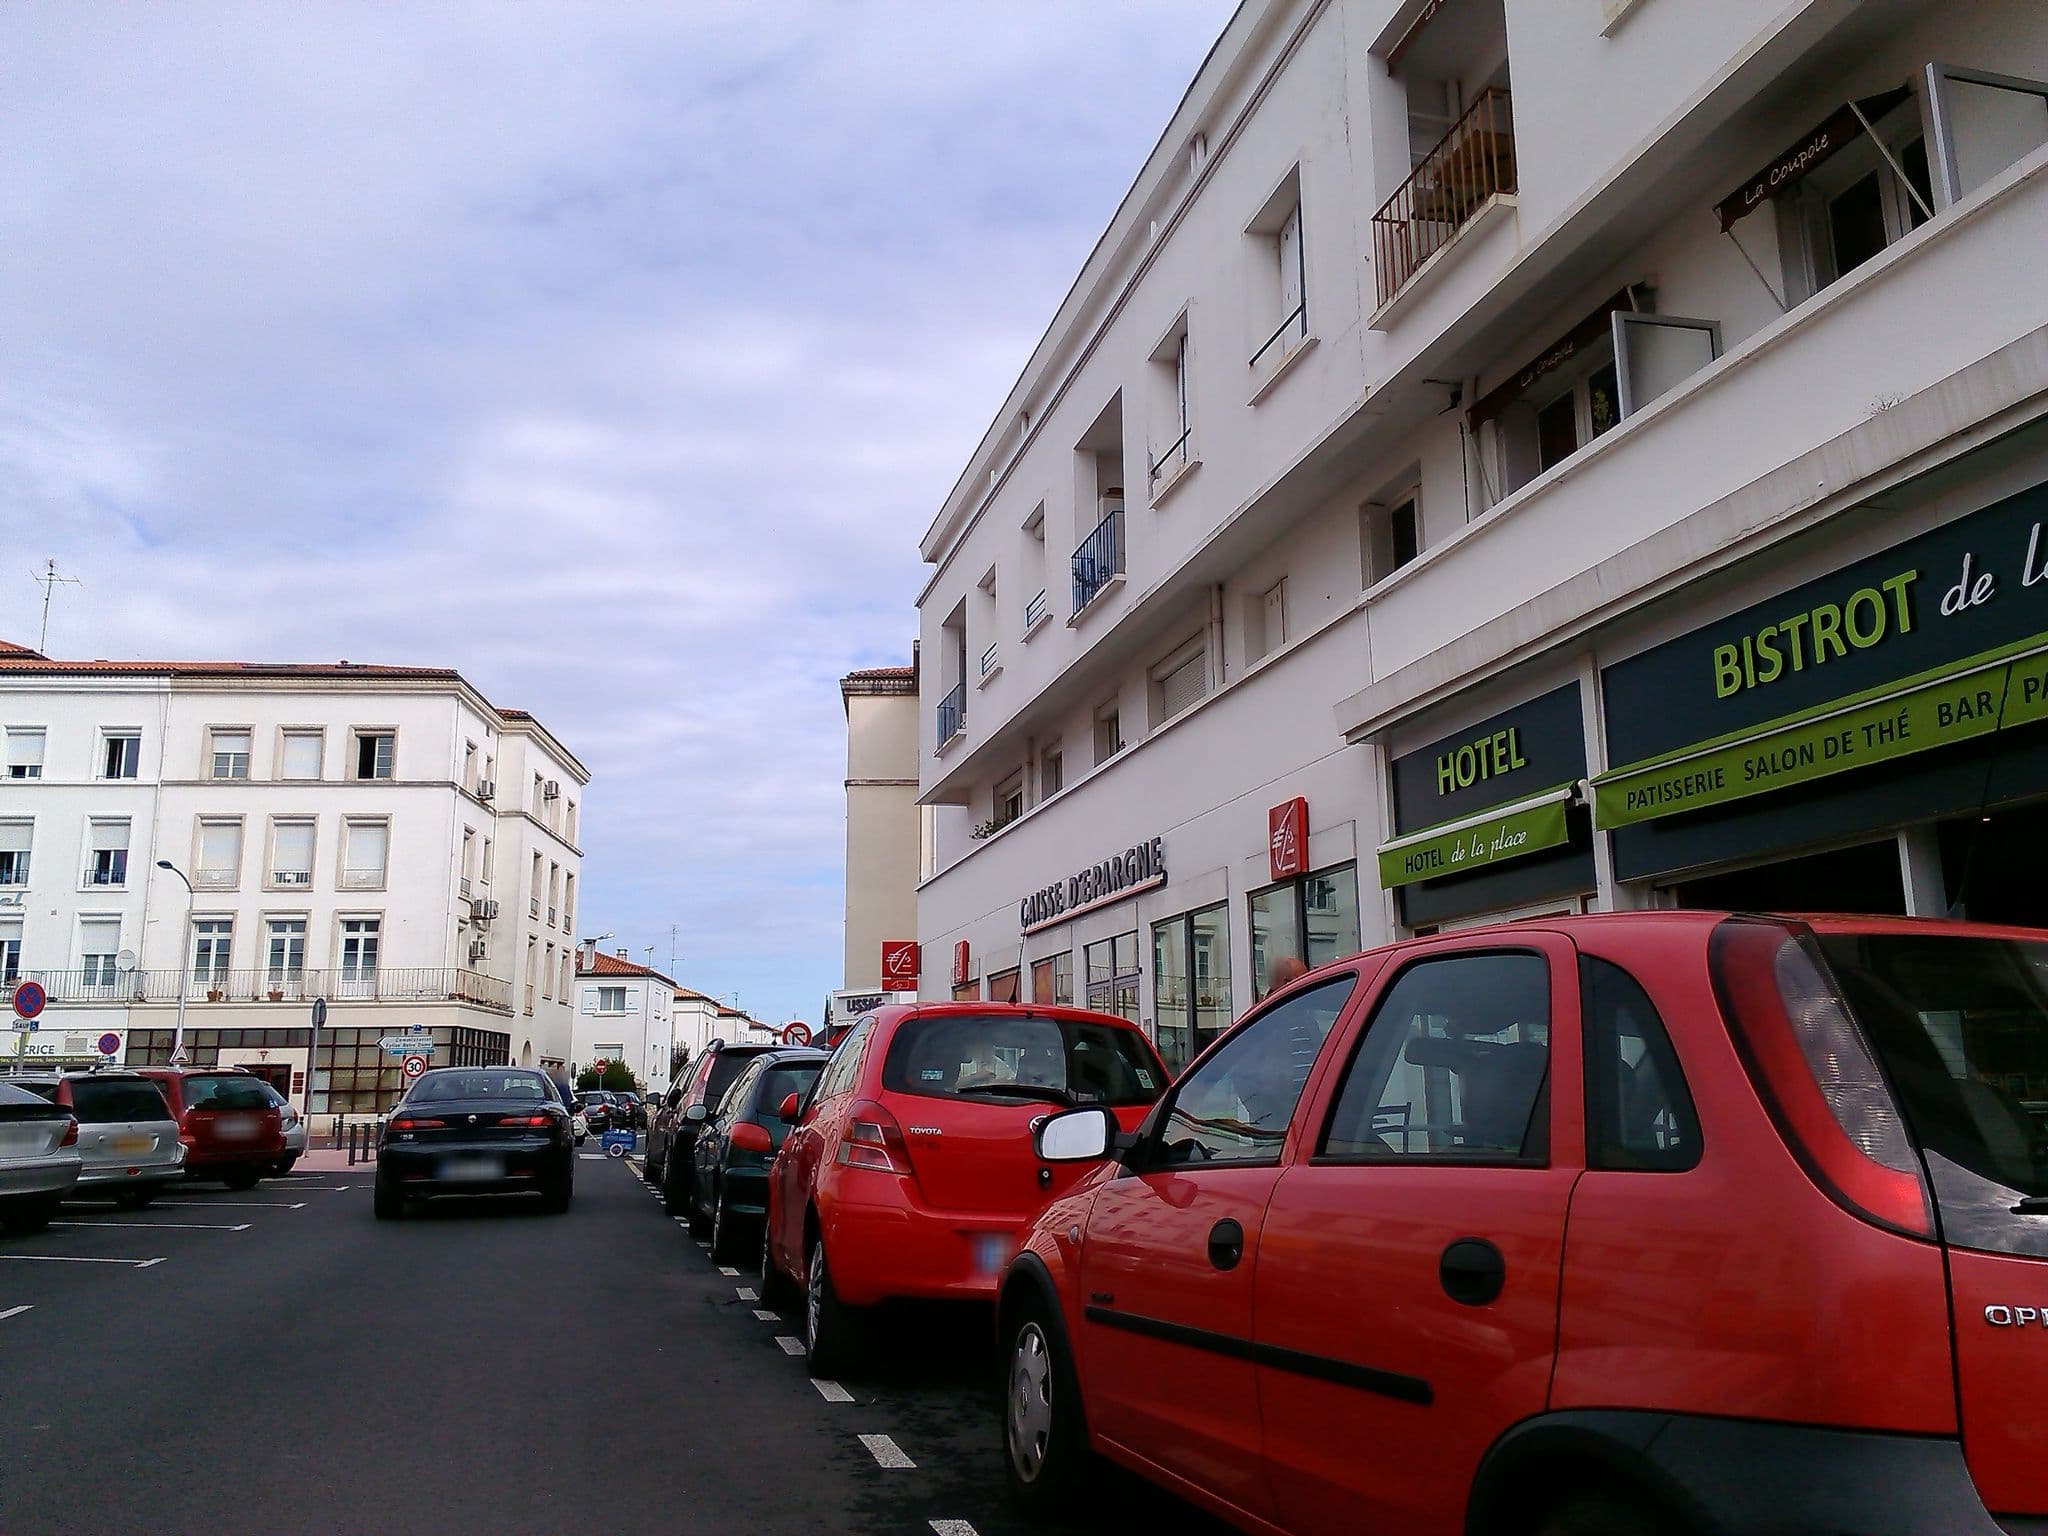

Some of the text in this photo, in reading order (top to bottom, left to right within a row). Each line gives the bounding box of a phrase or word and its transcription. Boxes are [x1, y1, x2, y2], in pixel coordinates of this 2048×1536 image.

[1745, 134, 1829, 204] La Coupole
[1713, 522, 2048, 699] BISTROT de l
[1437, 727, 1526, 796] HOTEL
[1627, 768, 1725, 810] PATISSERIE
[1744, 742, 1815, 781] SALON
[1824, 731, 1854, 760] DE
[1861, 707, 1911, 748] THÉ
[1937, 691, 1994, 727] BAR
[1021, 837, 1163, 927] CAISSE D'EPARGNE
[1405, 825, 1528, 874] HOTEL de la place
[408, 1062, 421, 1072] 30
[909, 1127, 942, 1135] TOYOTA
